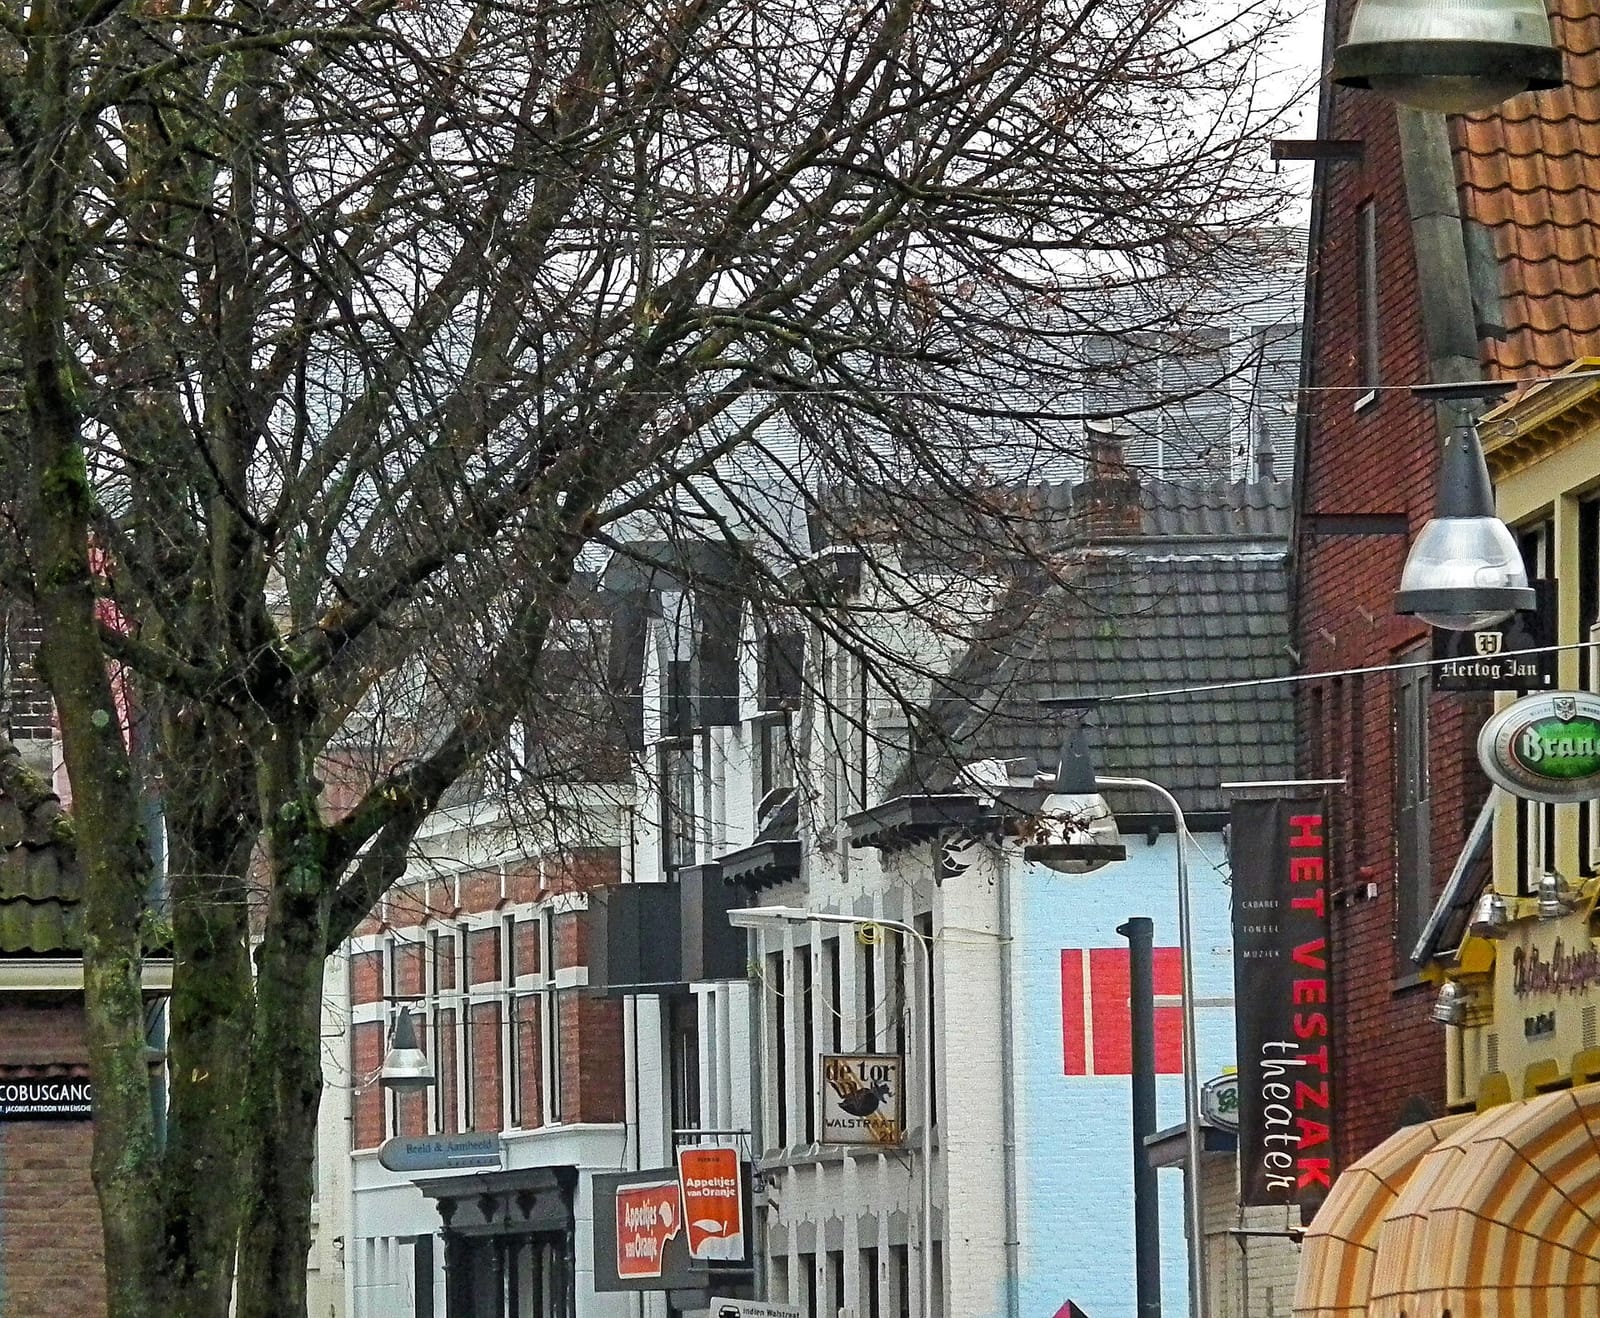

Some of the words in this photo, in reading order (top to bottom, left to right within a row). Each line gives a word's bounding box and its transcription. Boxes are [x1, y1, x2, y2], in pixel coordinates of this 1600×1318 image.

[1440, 661, 1501, 680] Hertog
[1503, 659, 1537, 677] Jan
[1523, 726, 1600, 762] Bran
[1289, 815, 1325, 917] HET
[1241, 900, 1280, 909] CABARET
[826, 1059, 852, 1081] de
[857, 1060, 896, 1082] tor
[1292, 937, 1331, 1189] VESTZAK
[825, 1119, 895, 1129] WALSTRAAT
[1259, 1040, 1307, 1192] theater
[686, 1177, 736, 1188] Appeltjes
[702, 1187, 736, 1198] Oranje
[625, 1198, 657, 1232] Appeltjes
[635, 1228, 658, 1262] Oranje
